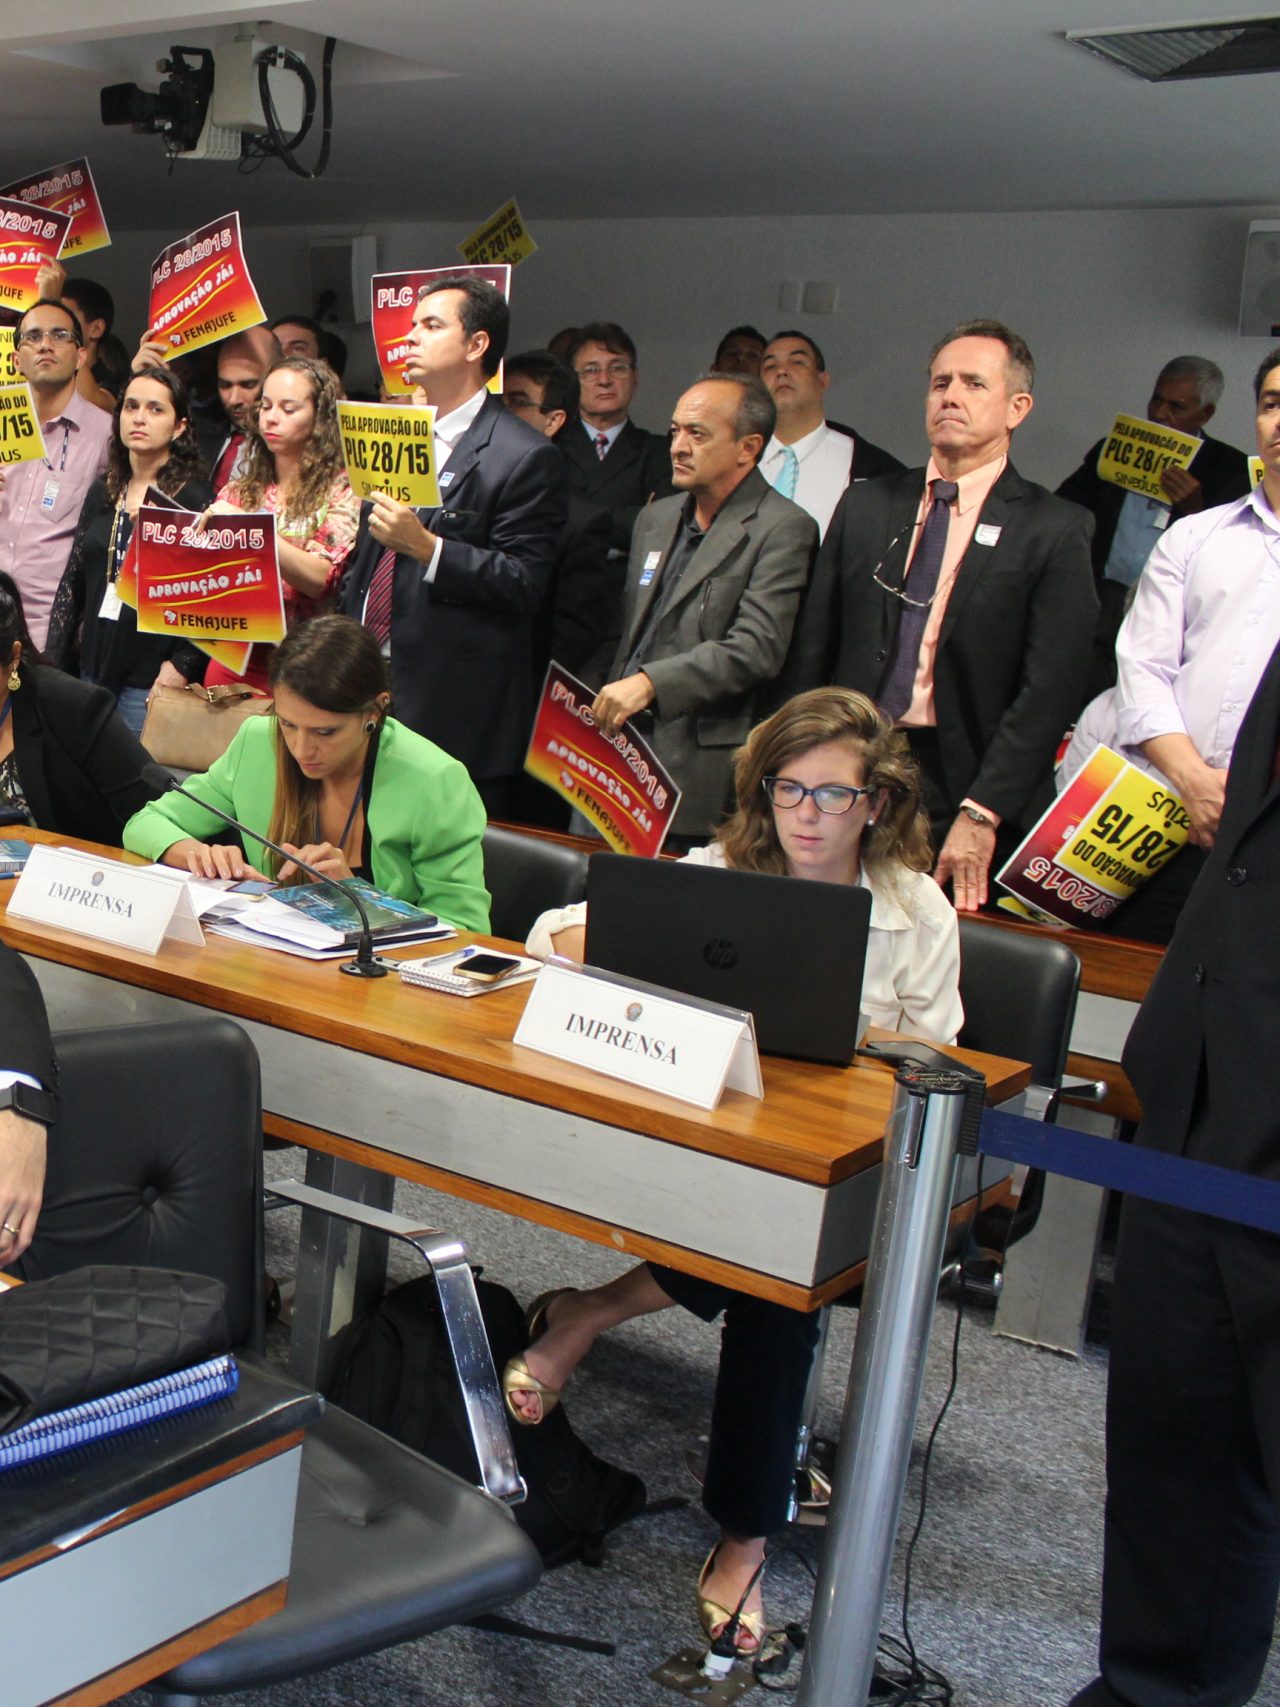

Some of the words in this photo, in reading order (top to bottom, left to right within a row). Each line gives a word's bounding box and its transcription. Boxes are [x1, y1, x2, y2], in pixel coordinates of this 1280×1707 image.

[20, 170, 84, 202] 28/2015
[488, 219, 522, 259] 28/15
[152, 260, 171, 290] PLC
[174, 228, 232, 273] 28/2015
[153, 279, 213, 330] APROVAÇÃO
[216, 263, 235, 286] JÁ!
[377, 286, 413, 309] PLC
[183, 311, 237, 342] FENAJUFE
[13, 395, 28, 409] DO
[341, 414, 357, 431] PELA
[358, 416, 411, 439] APROVAÇÃO
[414, 420, 428, 437] DO
[1113, 421, 1129, 436] PELA
[1129, 427, 1178, 452] APROVAÇÃO
[1177, 442, 1192, 456] DO
[344, 437, 367, 470] PLC
[370, 440, 429, 475] 28/15
[1104, 438, 1133, 465] PLC
[142, 521, 177, 544] PLC
[179, 526, 265, 549] 28/2015
[148, 573, 230, 599] APROVAÇÃO
[235, 565, 263, 586] JÁ!
[181, 613, 248, 632] FENAJUFE
[550, 680, 595, 726] PLC
[599, 730, 668, 810] 8/2015
[547, 740, 631, 808] APROVAÇÃO
[577, 787, 632, 852] FENAJUFE
[1090, 804, 1180, 869] 28/15
[1072, 839, 1097, 862] DO
[48, 882, 133, 918] IMPRENSA
[566, 1013, 677, 1065] IMPRENSA
